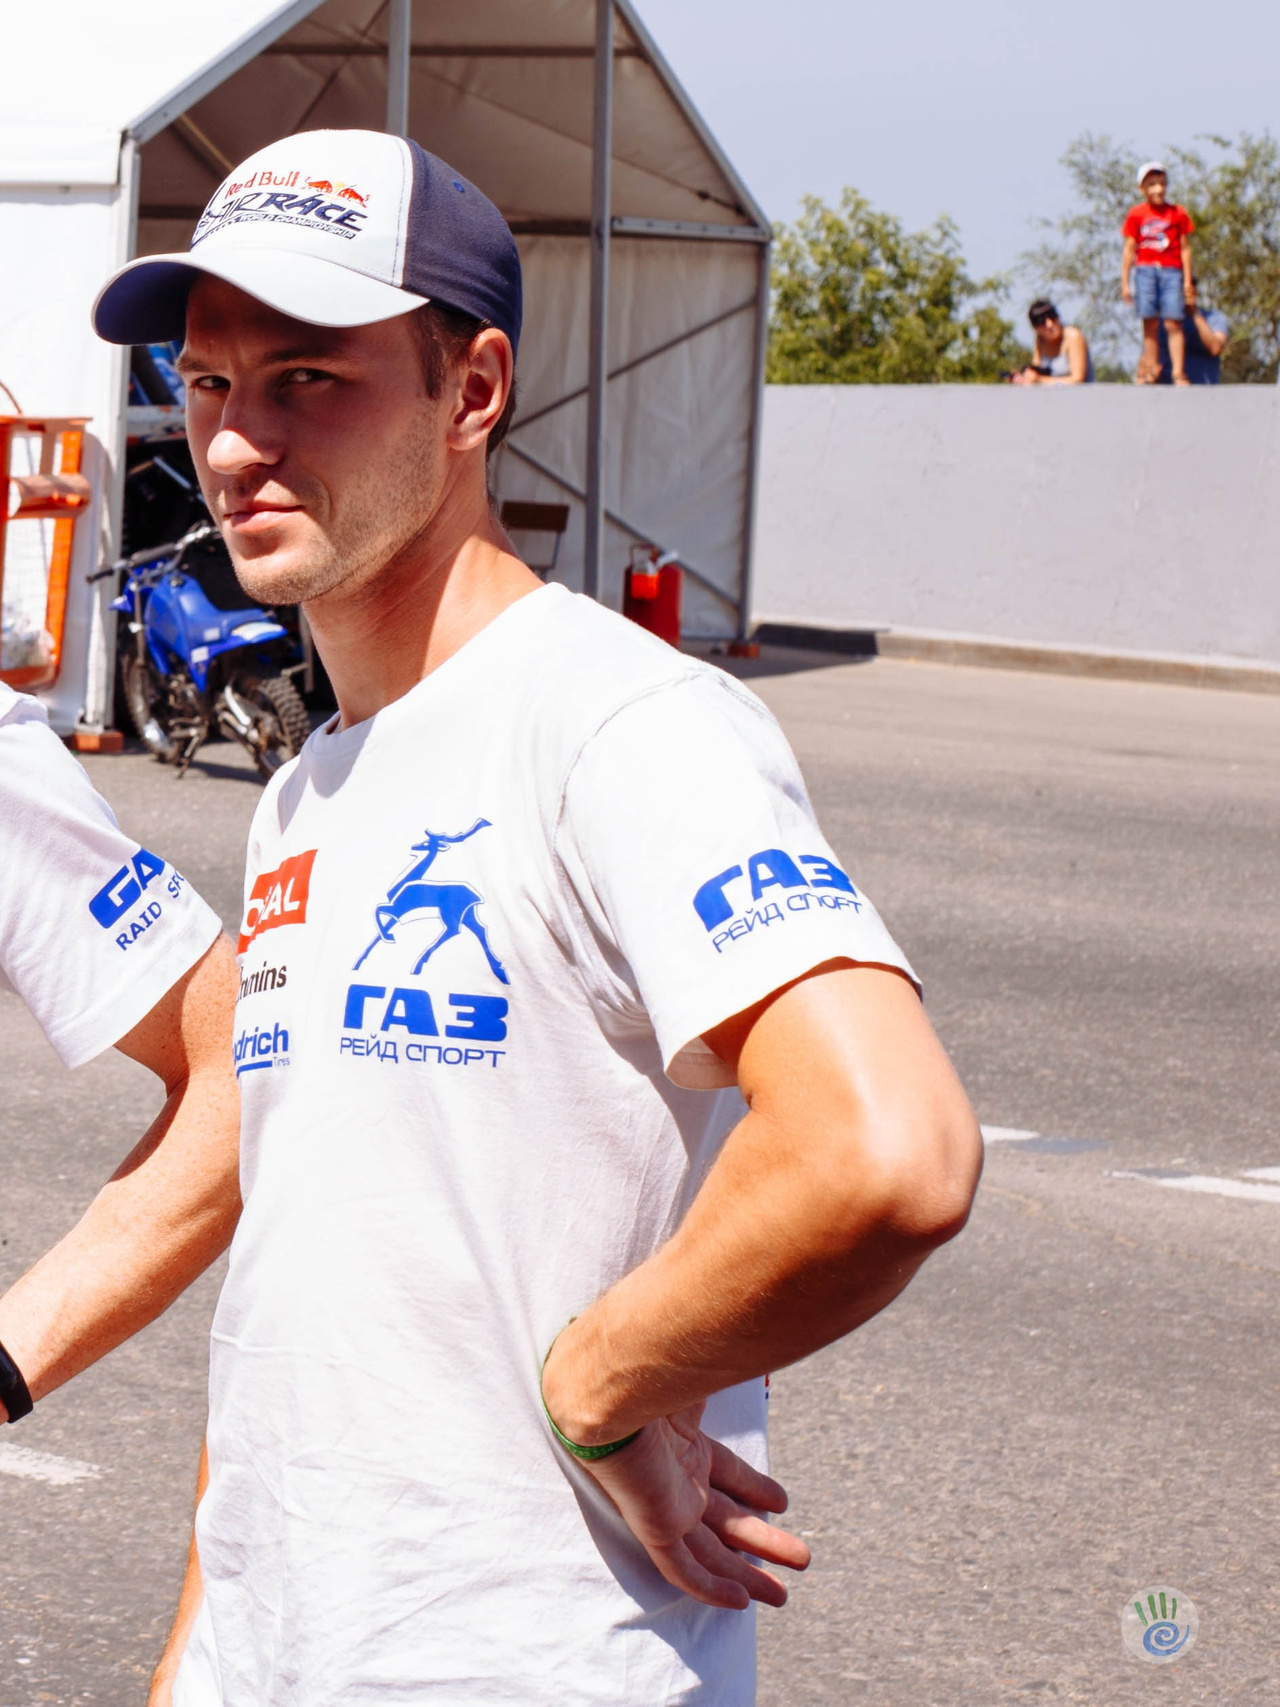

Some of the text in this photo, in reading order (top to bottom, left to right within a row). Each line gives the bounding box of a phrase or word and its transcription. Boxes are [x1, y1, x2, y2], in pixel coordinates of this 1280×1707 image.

[225, 171, 300, 199] Red Bull
[239, 213, 356, 240] WORLD CHAMPIONSHIP
[260, 192, 368, 232] RACE
[693, 849, 857, 932] ГАЗ
[116, 901, 162, 951] RAID
[712, 893, 862, 953] РЕЙД СПОРТ
[343, 984, 509, 1042] ГАЗ
[340, 1033, 506, 1067] РЕЙД СПОРТ
